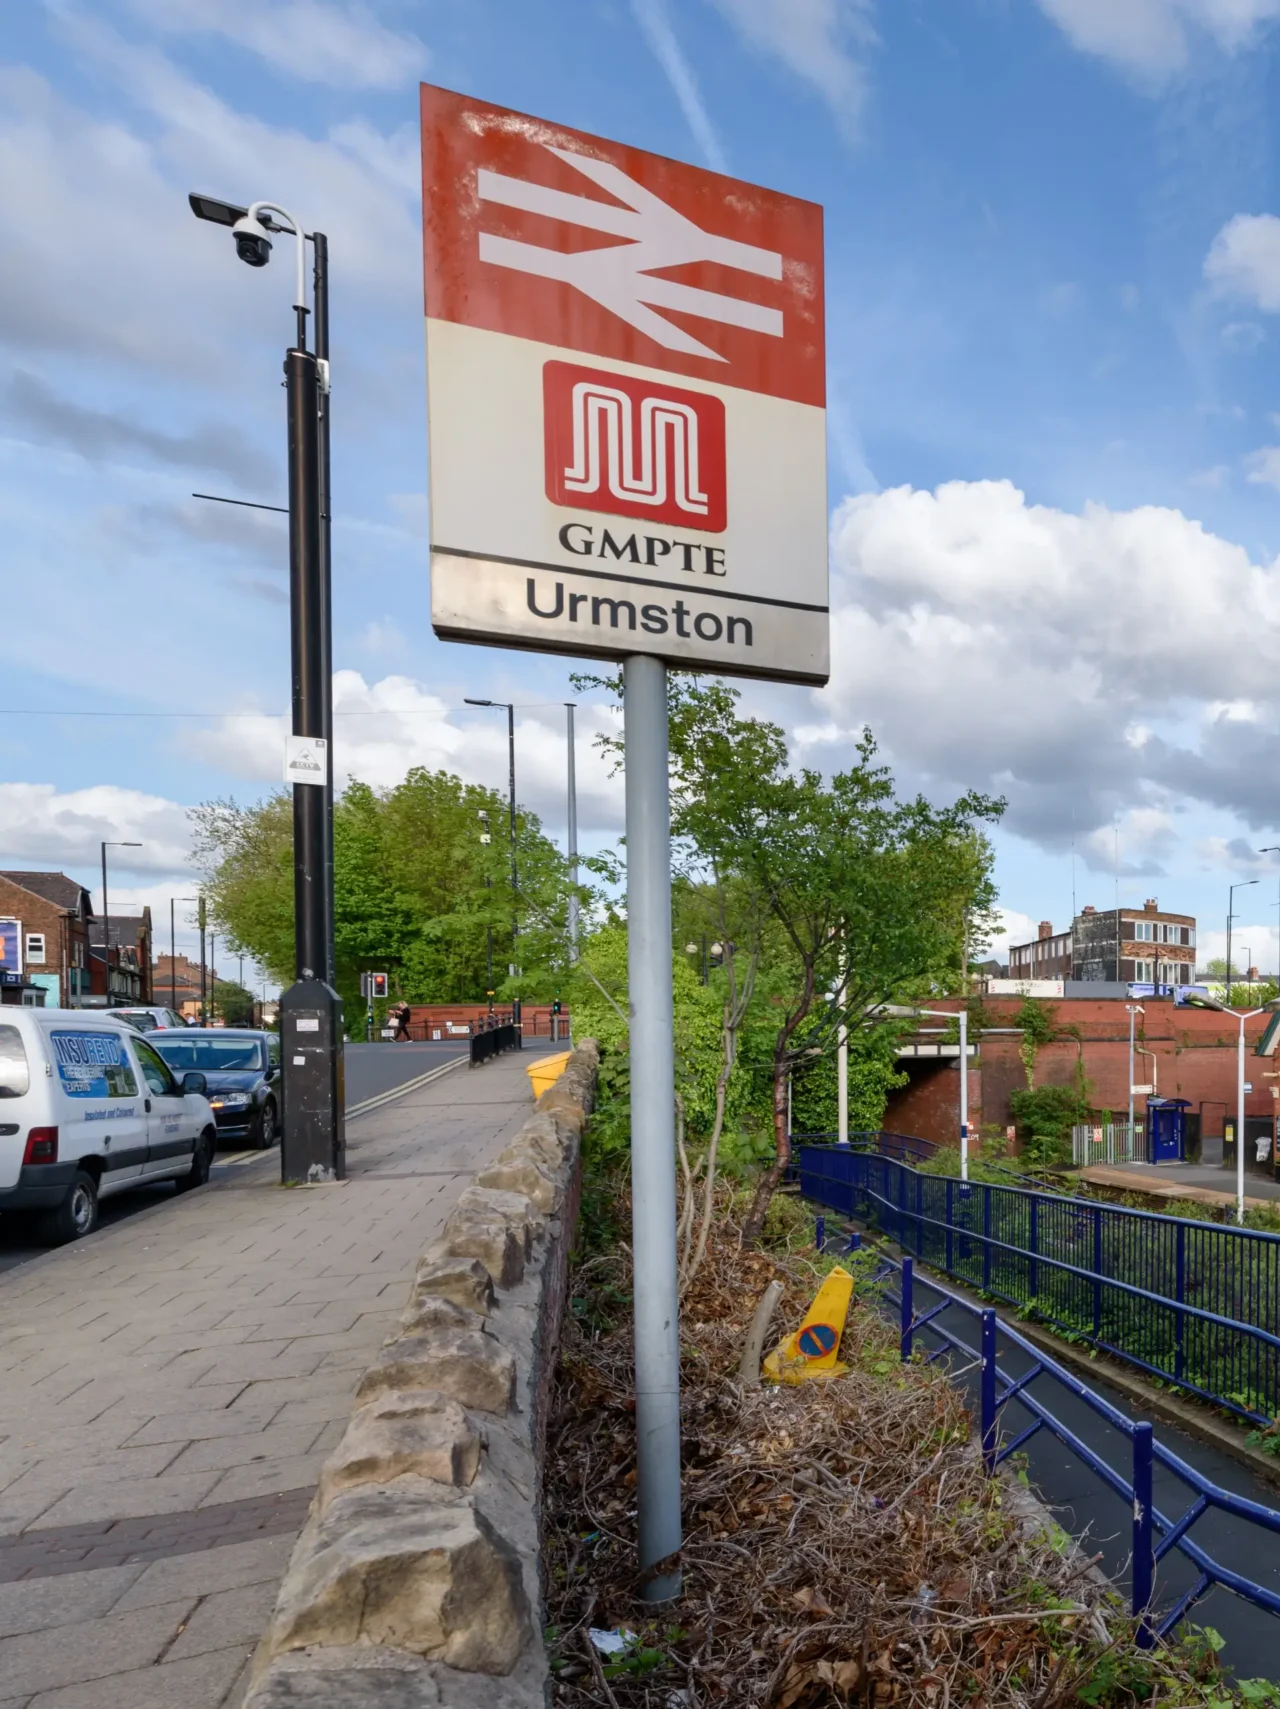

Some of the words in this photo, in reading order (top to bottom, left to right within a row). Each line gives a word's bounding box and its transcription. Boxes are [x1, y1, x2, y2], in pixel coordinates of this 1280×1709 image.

[558, 523, 728, 577] GMPTE
[526, 578, 753, 647] Urmston
[296, 761, 315, 769] CCTV
[52, 1036, 121, 1066] INSUREND
